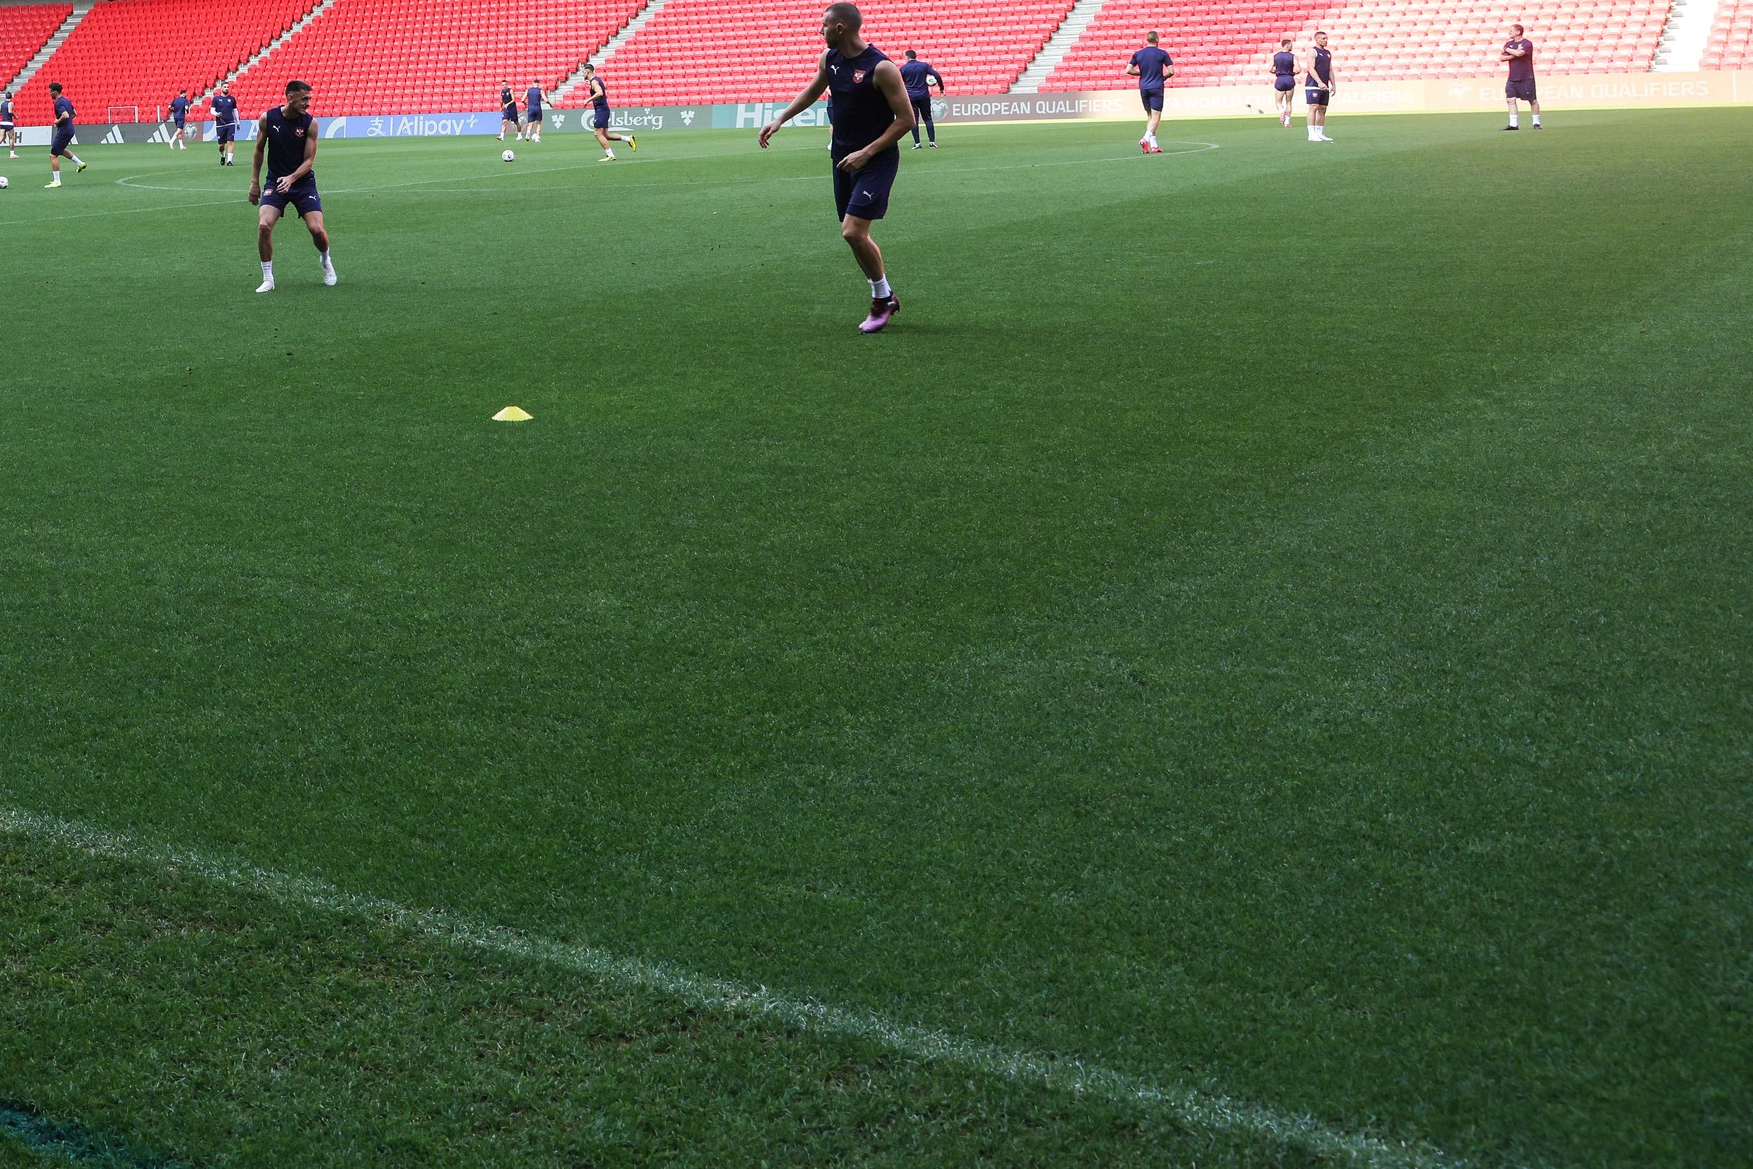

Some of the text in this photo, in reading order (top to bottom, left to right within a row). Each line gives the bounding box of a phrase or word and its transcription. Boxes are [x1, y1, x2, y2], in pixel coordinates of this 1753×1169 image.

[1479, 80, 1709, 102] EUPEAN QUALIFIERS
[952, 98, 1123, 117] EUROPEAN QUALIFIERS
